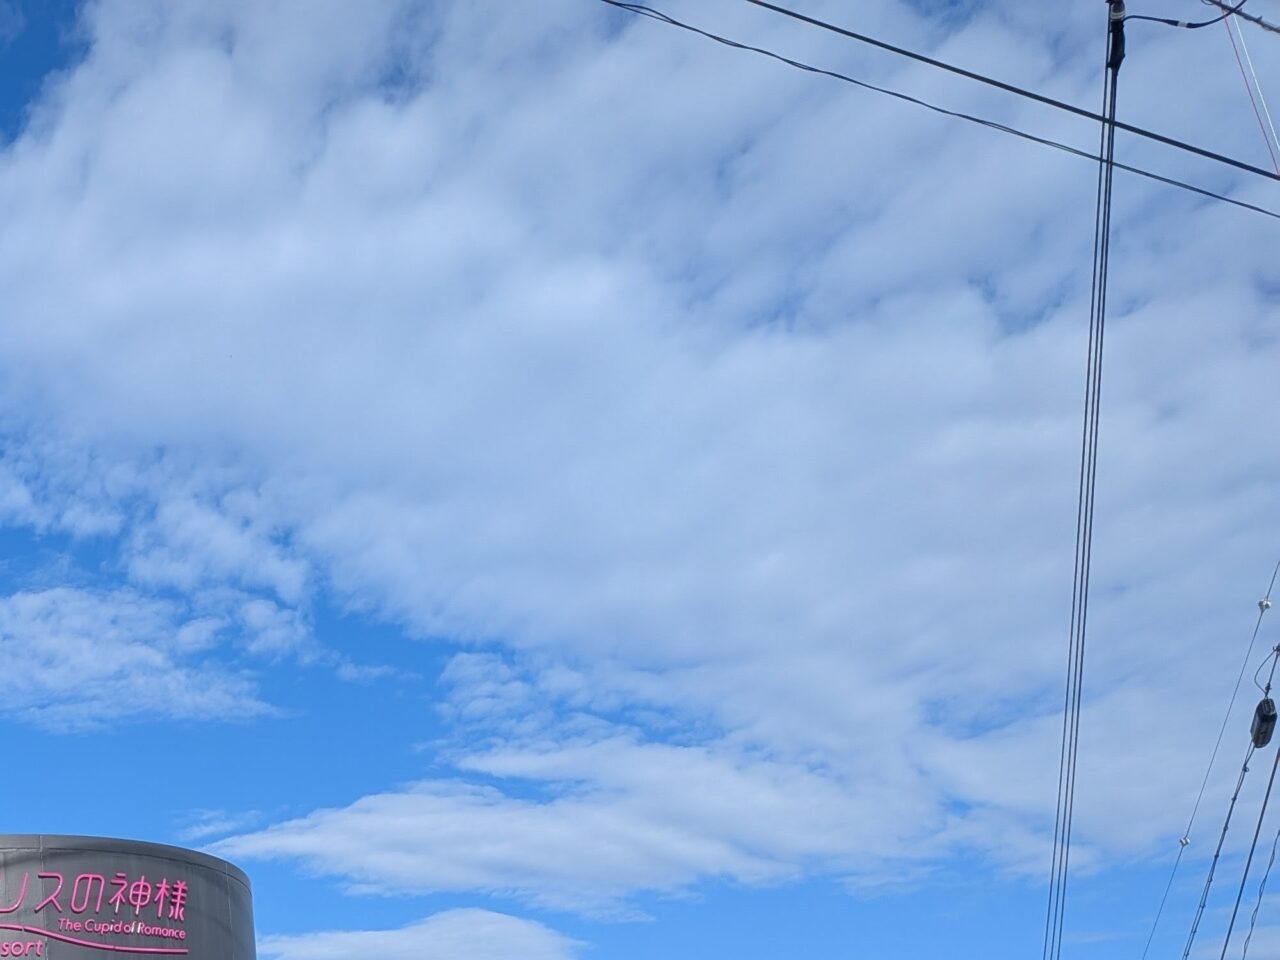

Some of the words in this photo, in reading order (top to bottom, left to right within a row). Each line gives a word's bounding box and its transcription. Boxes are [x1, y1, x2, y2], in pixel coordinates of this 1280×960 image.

[58, 918, 81, 932] The
[84, 919, 122, 935] Cupid
[123, 920, 136, 933] of
[136, 922, 187, 940] Romance
